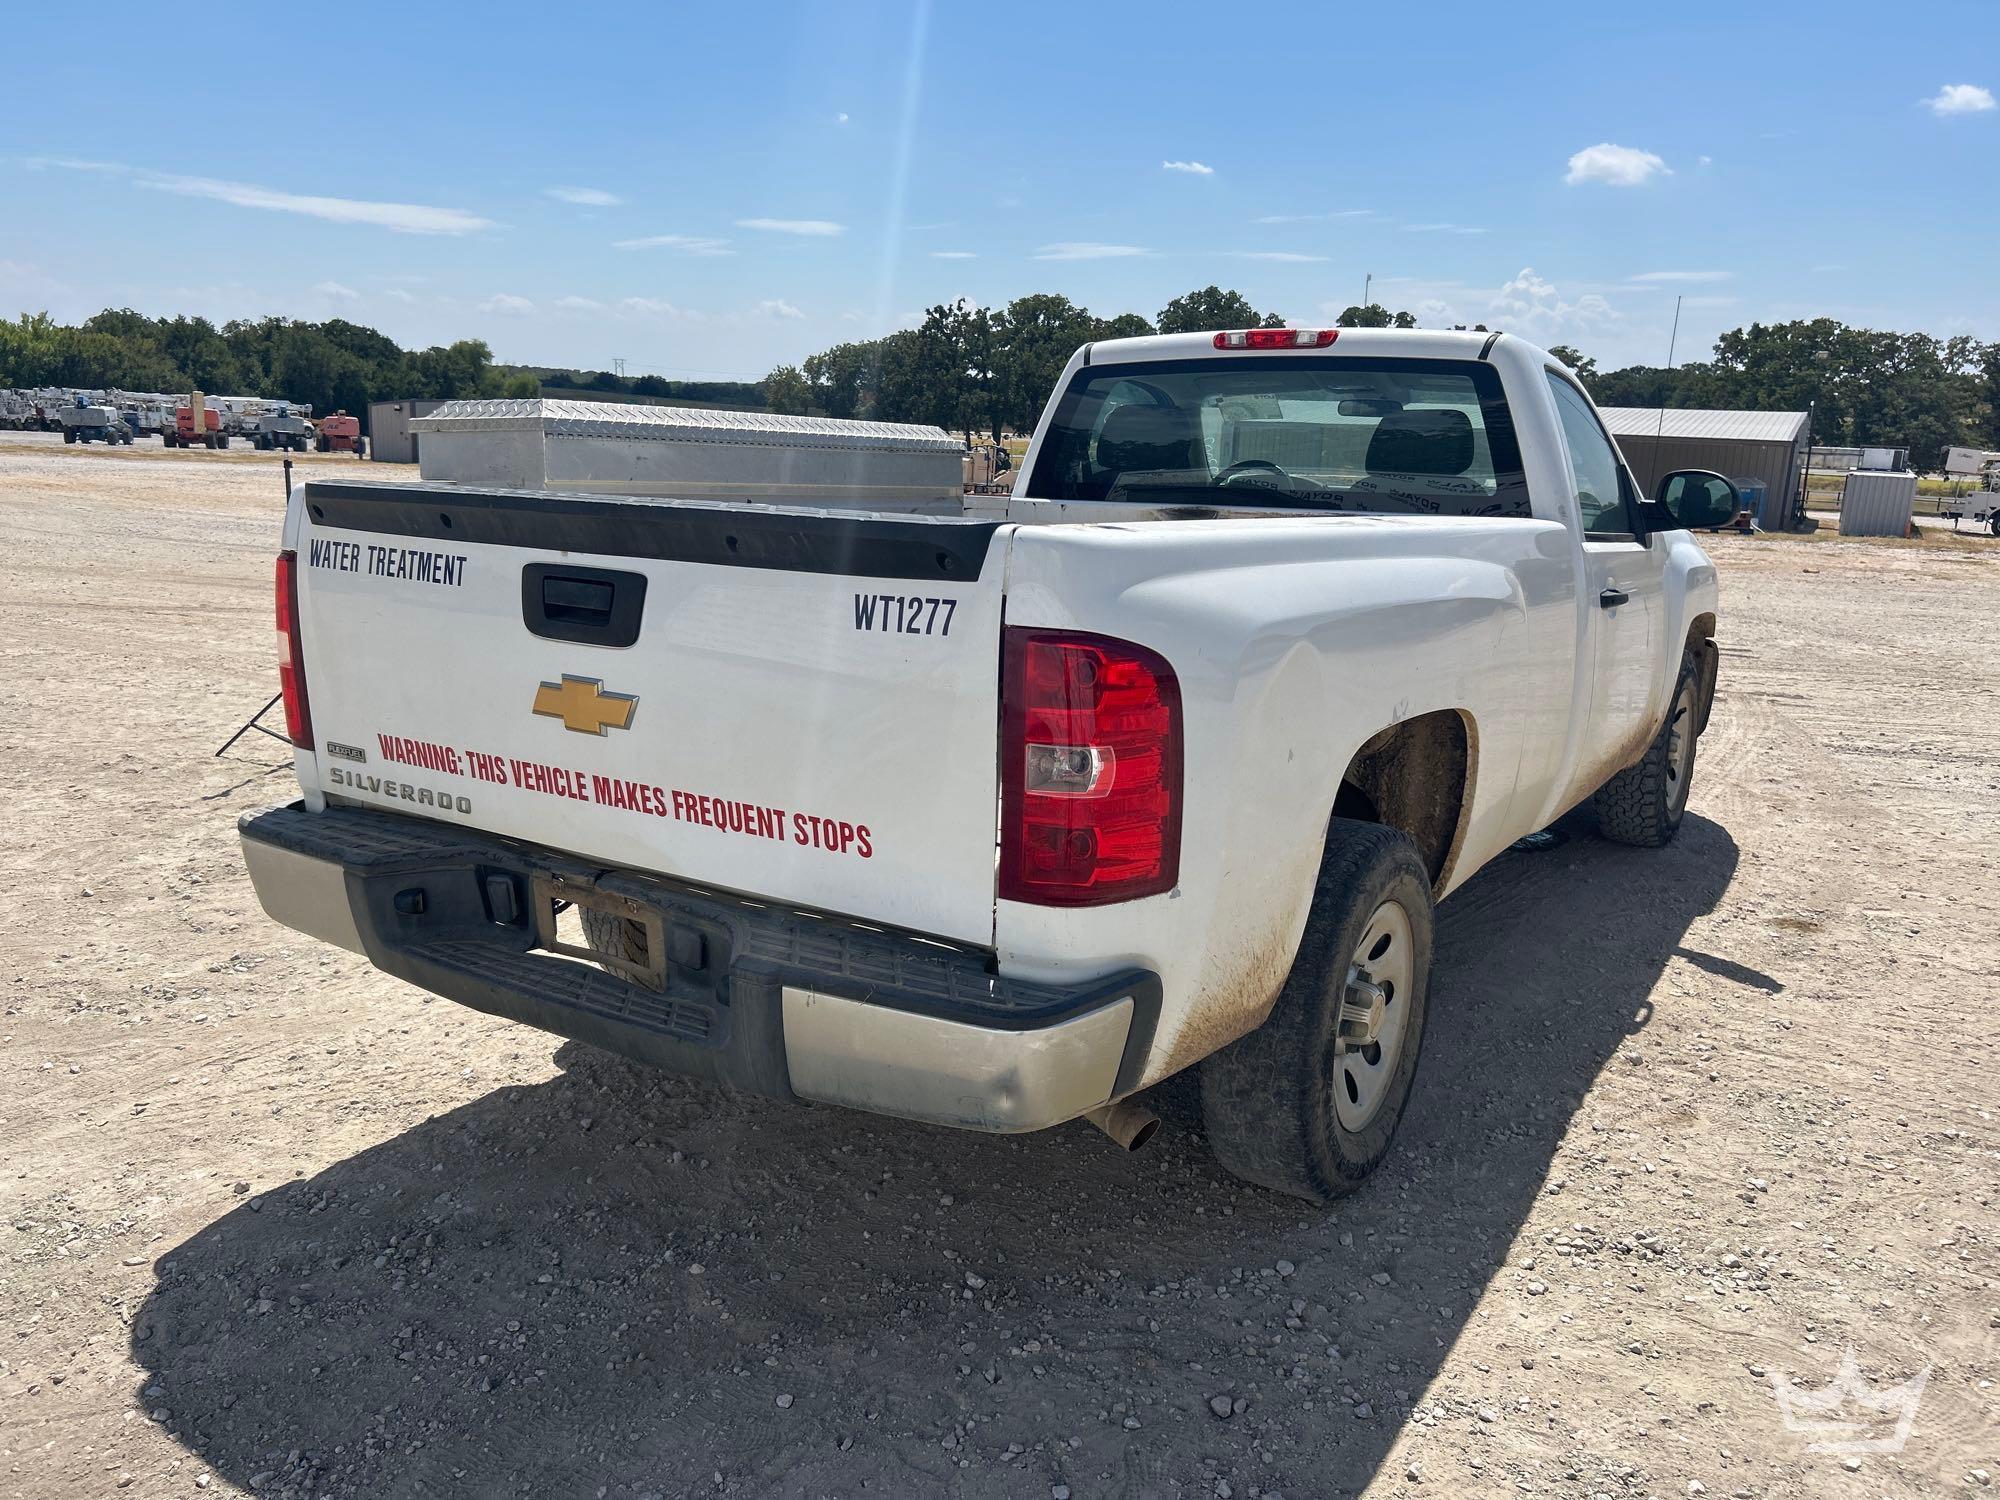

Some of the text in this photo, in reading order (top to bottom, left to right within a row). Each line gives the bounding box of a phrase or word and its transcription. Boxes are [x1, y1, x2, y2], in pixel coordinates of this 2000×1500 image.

[310, 538, 468, 587] WATER TREATMENT
[854, 593, 958, 637] WT1277
[330, 767, 472, 815] SILVERADO
[377, 733, 874, 859] WARNING: THIS VEHICLE MAKES FREQUENT STOPS
